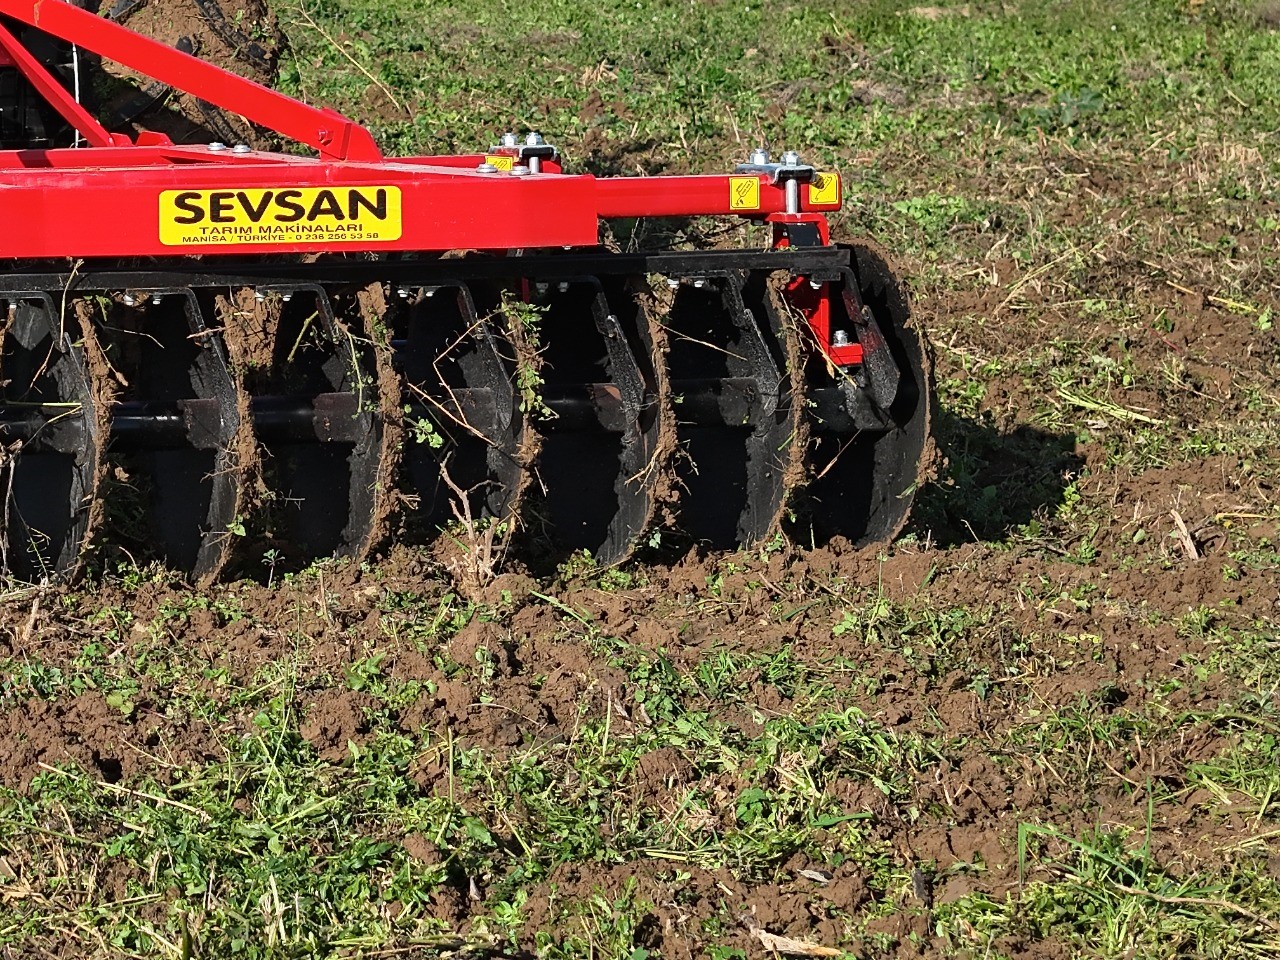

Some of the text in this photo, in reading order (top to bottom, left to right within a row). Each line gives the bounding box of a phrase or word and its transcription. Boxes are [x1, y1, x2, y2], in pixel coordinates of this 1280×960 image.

[174, 189, 387, 224] SEVSAN
[199, 223, 363, 235] TARIM MAKİNALARI
[182, 234, 227, 243] MANİSA
[237, 233, 286, 242] TÜRKİYE
